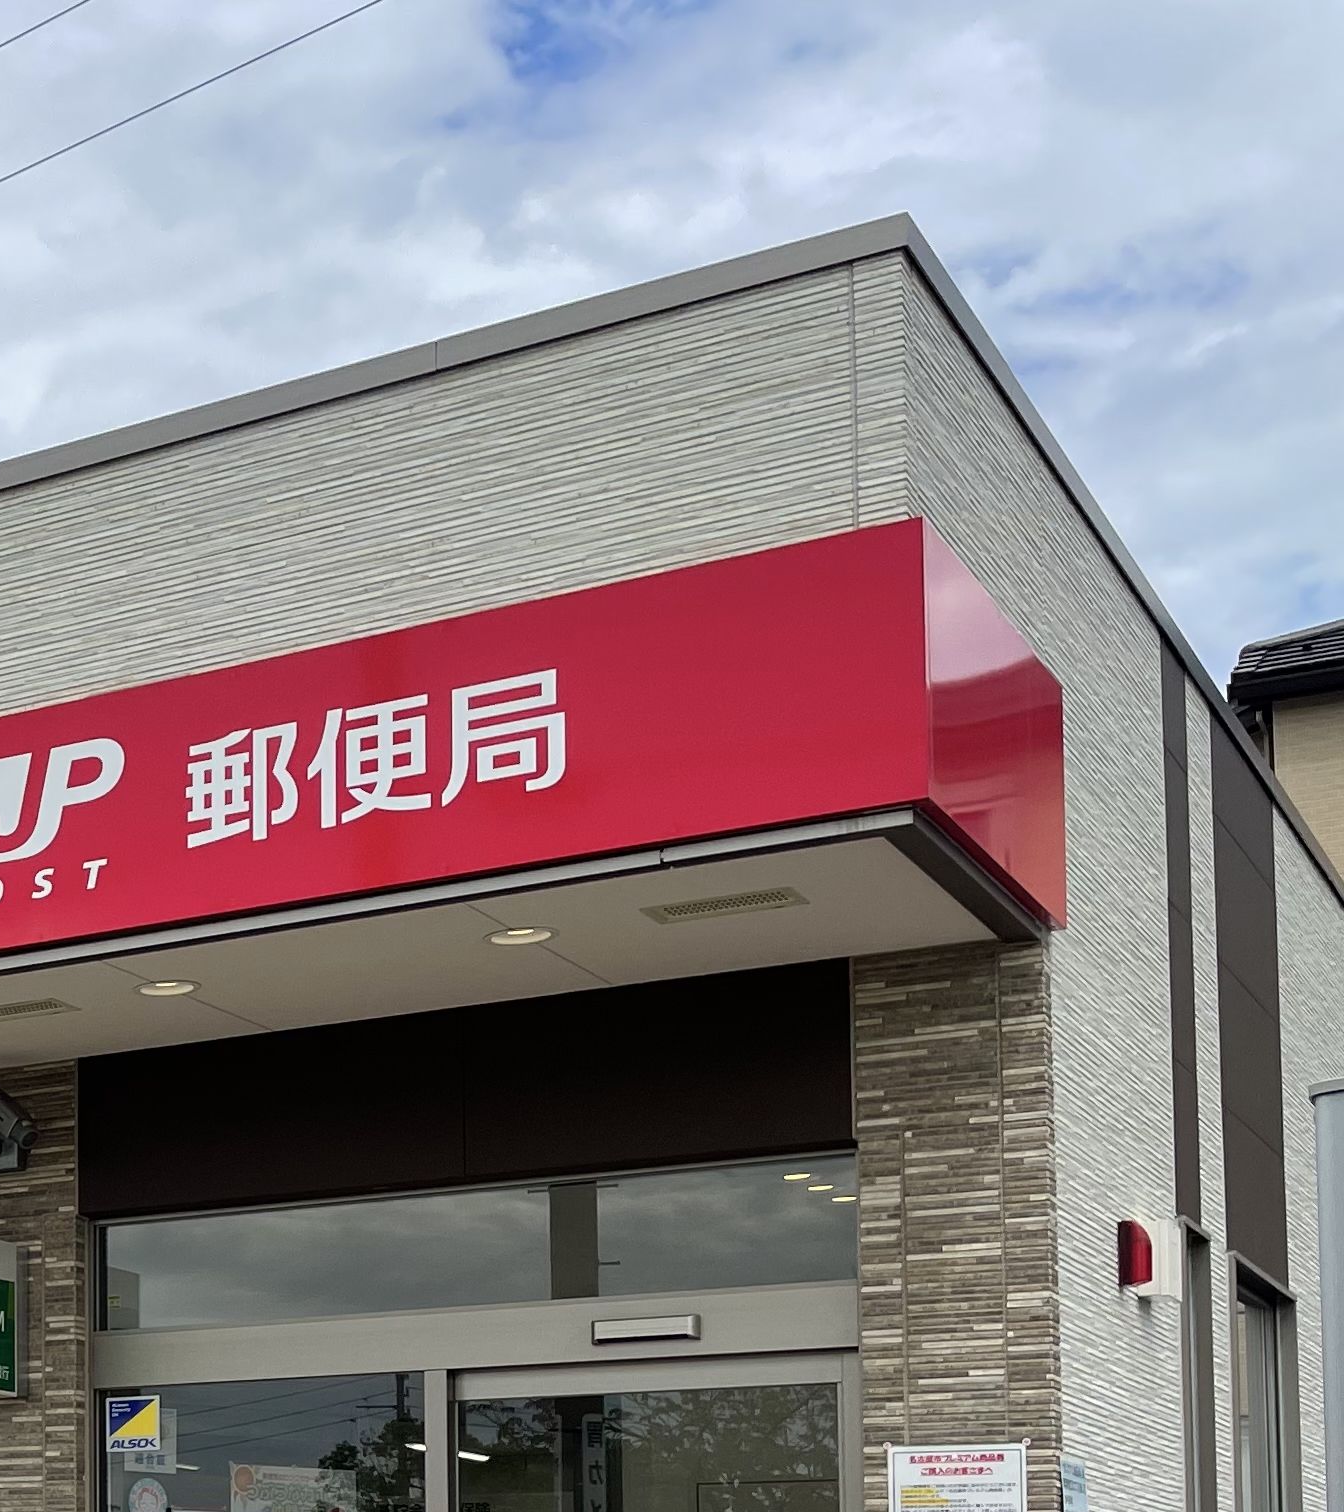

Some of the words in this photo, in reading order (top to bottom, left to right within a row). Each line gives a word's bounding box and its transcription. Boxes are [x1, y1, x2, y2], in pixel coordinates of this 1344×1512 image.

[186, 668, 568, 849] 郵便局
[110, 1438, 157, 1449] ALSOK
